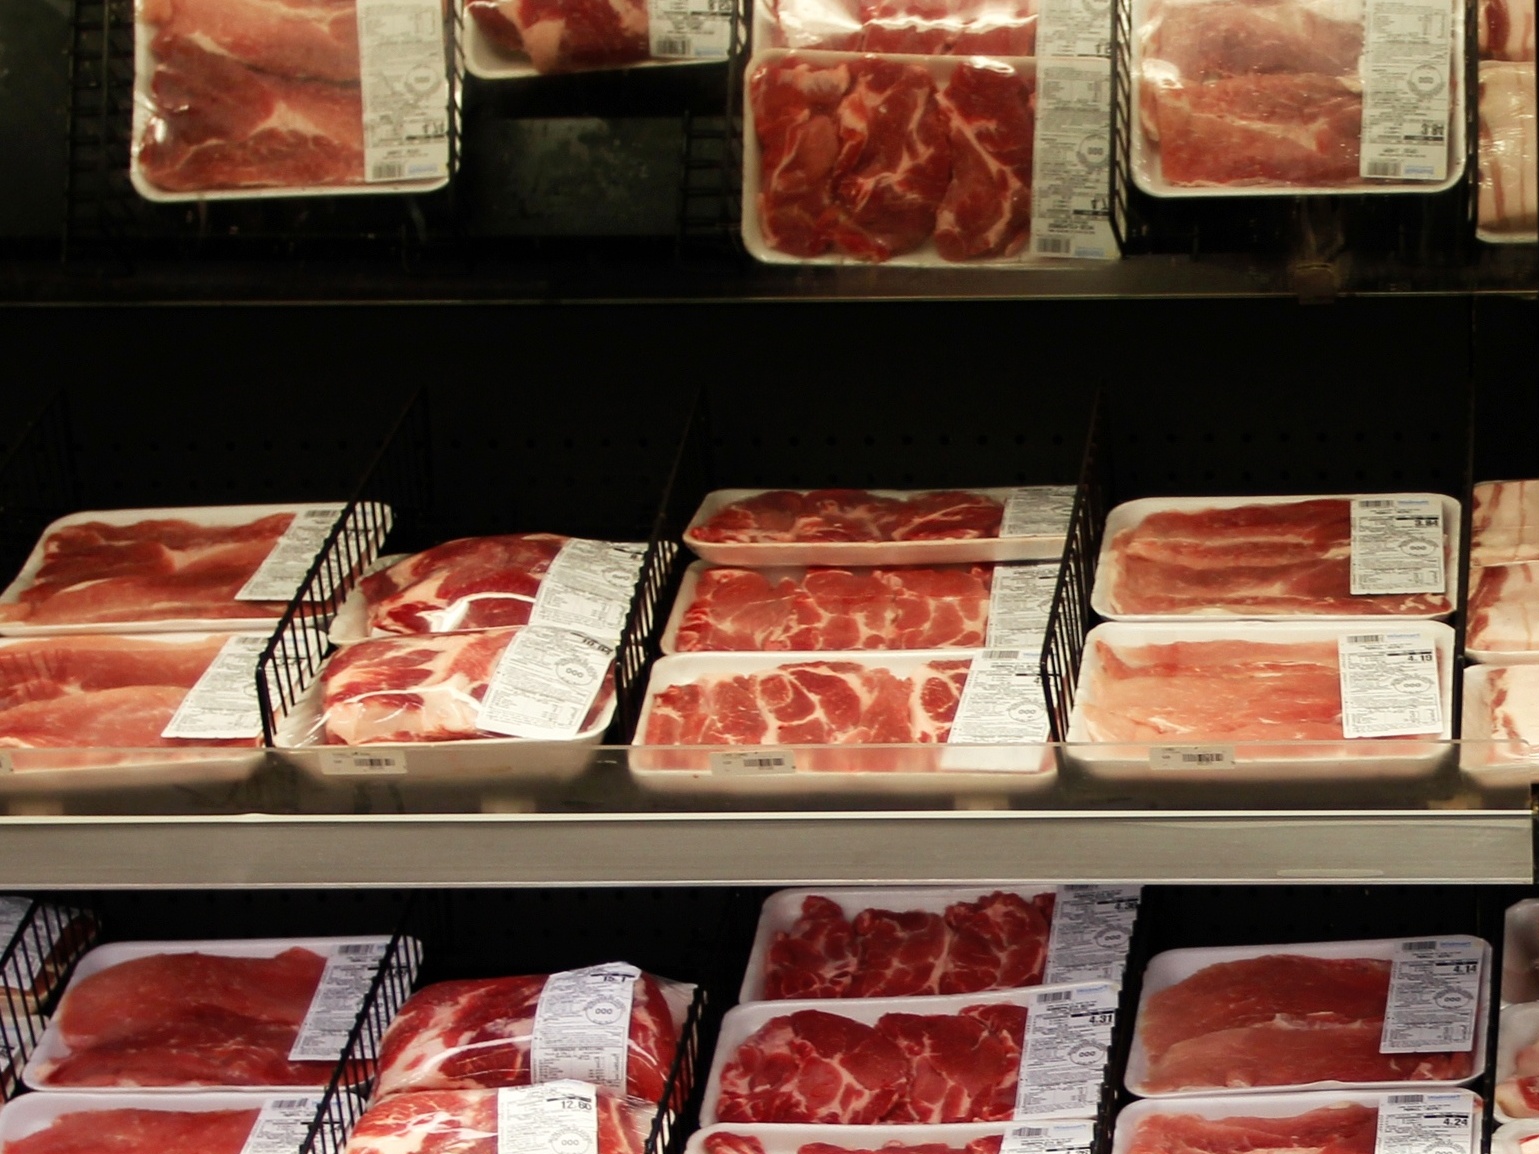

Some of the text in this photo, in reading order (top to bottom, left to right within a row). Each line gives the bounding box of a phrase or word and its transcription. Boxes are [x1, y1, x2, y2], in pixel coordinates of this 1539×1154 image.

[1453, 964, 1477, 973] 4.14
[1088, 1014, 1113, 1024] 4.31
[1443, 1118, 1468, 1127] 4.24
